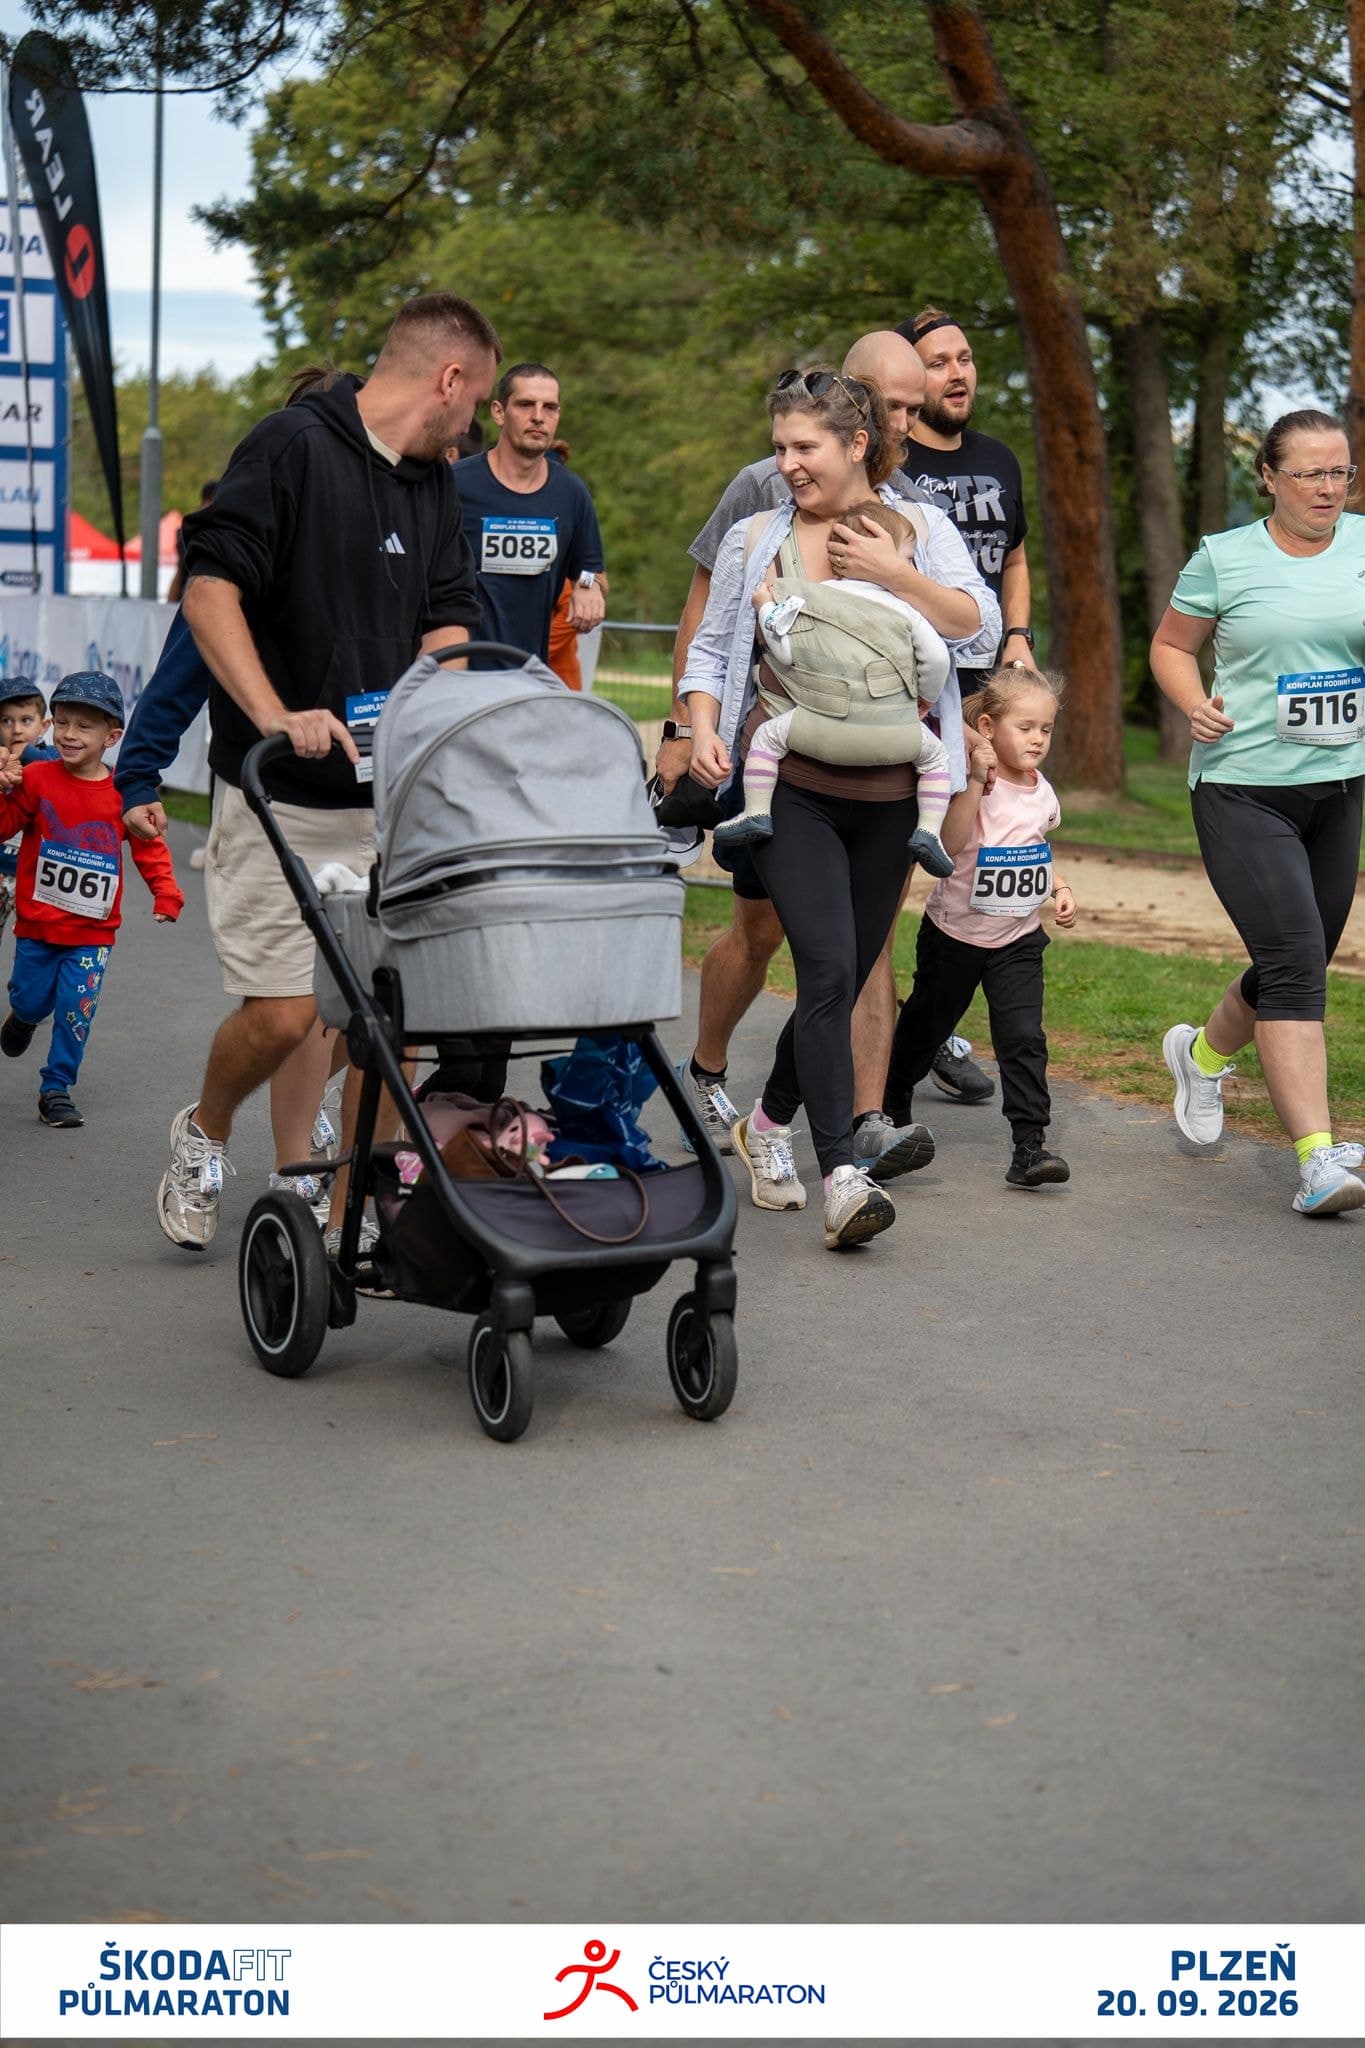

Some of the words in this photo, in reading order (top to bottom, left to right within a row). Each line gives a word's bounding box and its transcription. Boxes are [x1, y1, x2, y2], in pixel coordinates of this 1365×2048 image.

[485, 535, 551, 559] 5082
[1286, 681, 1322, 690] KONPLAN
[1287, 692, 1357, 727] 5116
[47, 848, 77, 862] KONPLAN
[985, 855, 1016, 863] KONPLAN
[40, 861, 111, 901] 5061
[975, 866, 1047, 898] 5080
